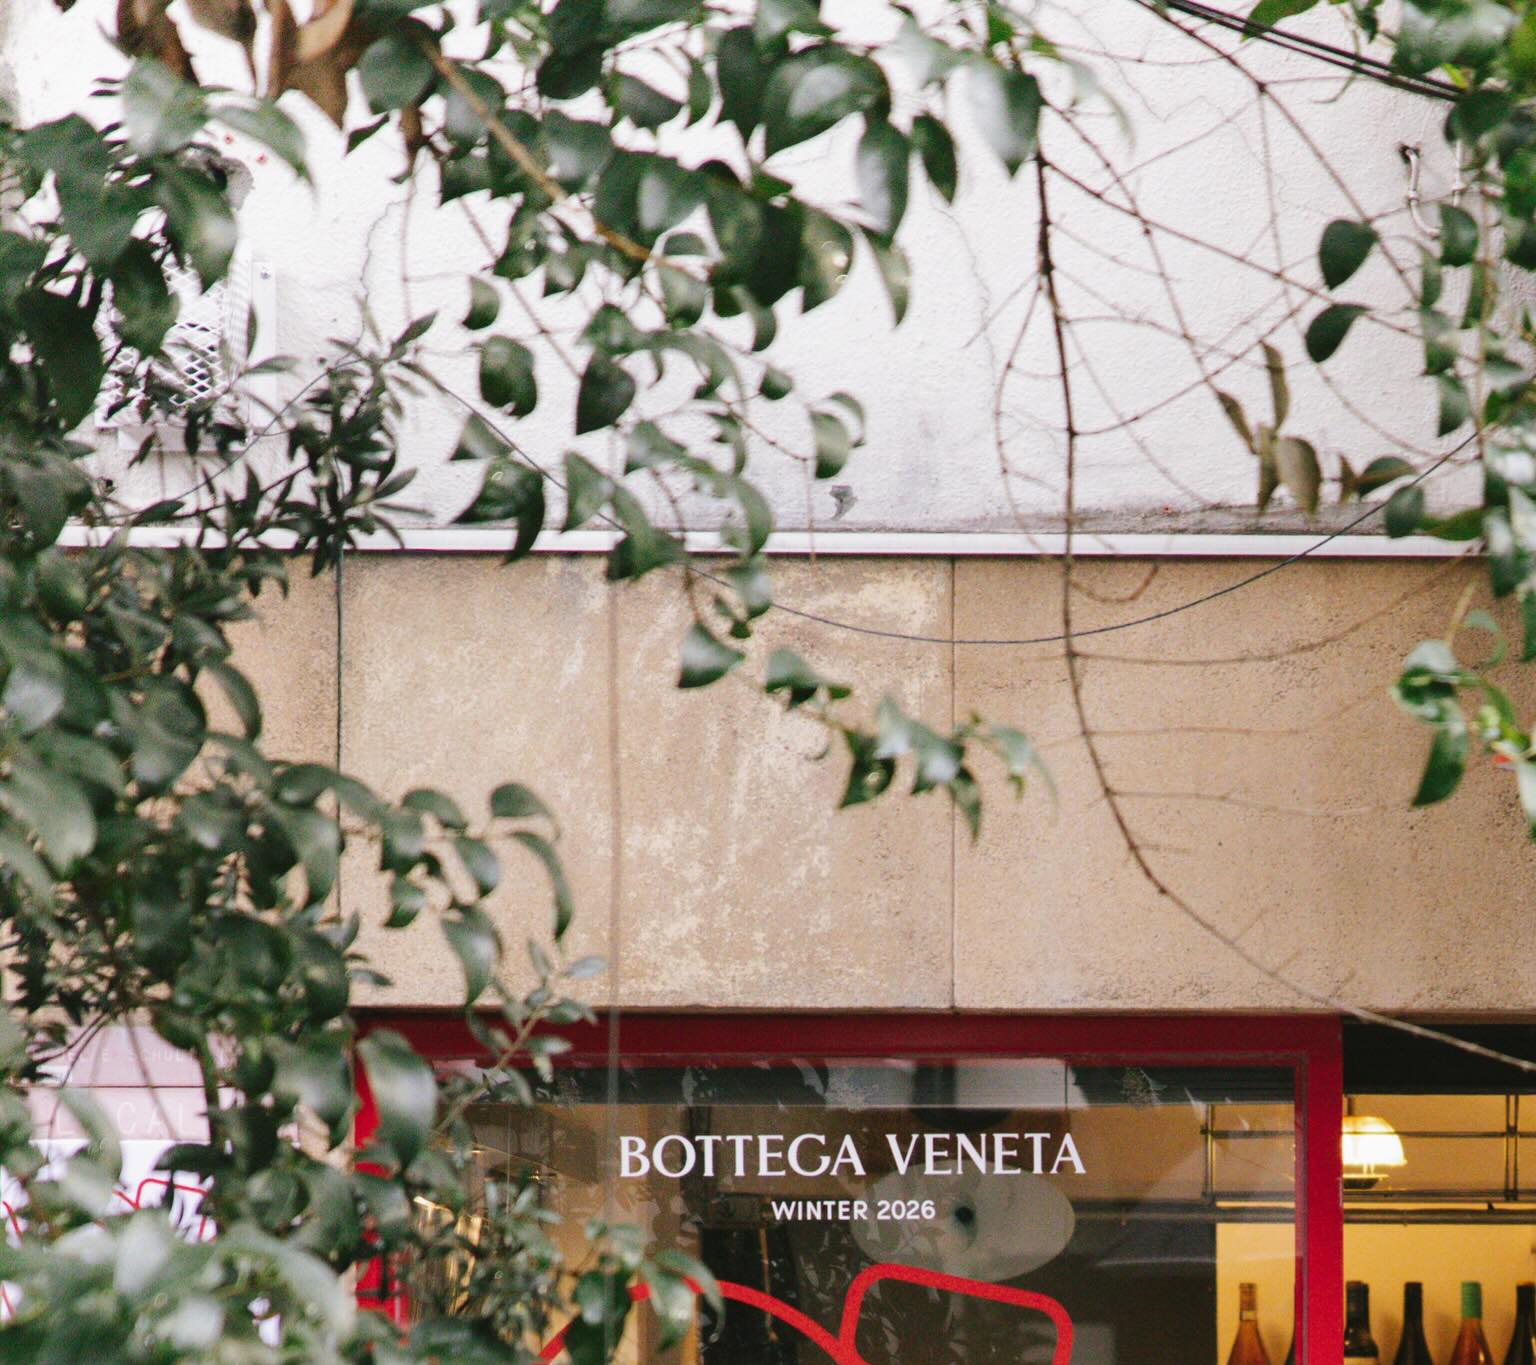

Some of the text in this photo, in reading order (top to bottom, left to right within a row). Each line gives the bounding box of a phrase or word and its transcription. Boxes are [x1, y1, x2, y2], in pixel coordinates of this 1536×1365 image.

[56, 1101, 197, 1135] LCAL
[619, 1132, 1087, 1178] BOTTEGA VENETA
[771, 1200, 936, 1221] WINTER 2026
